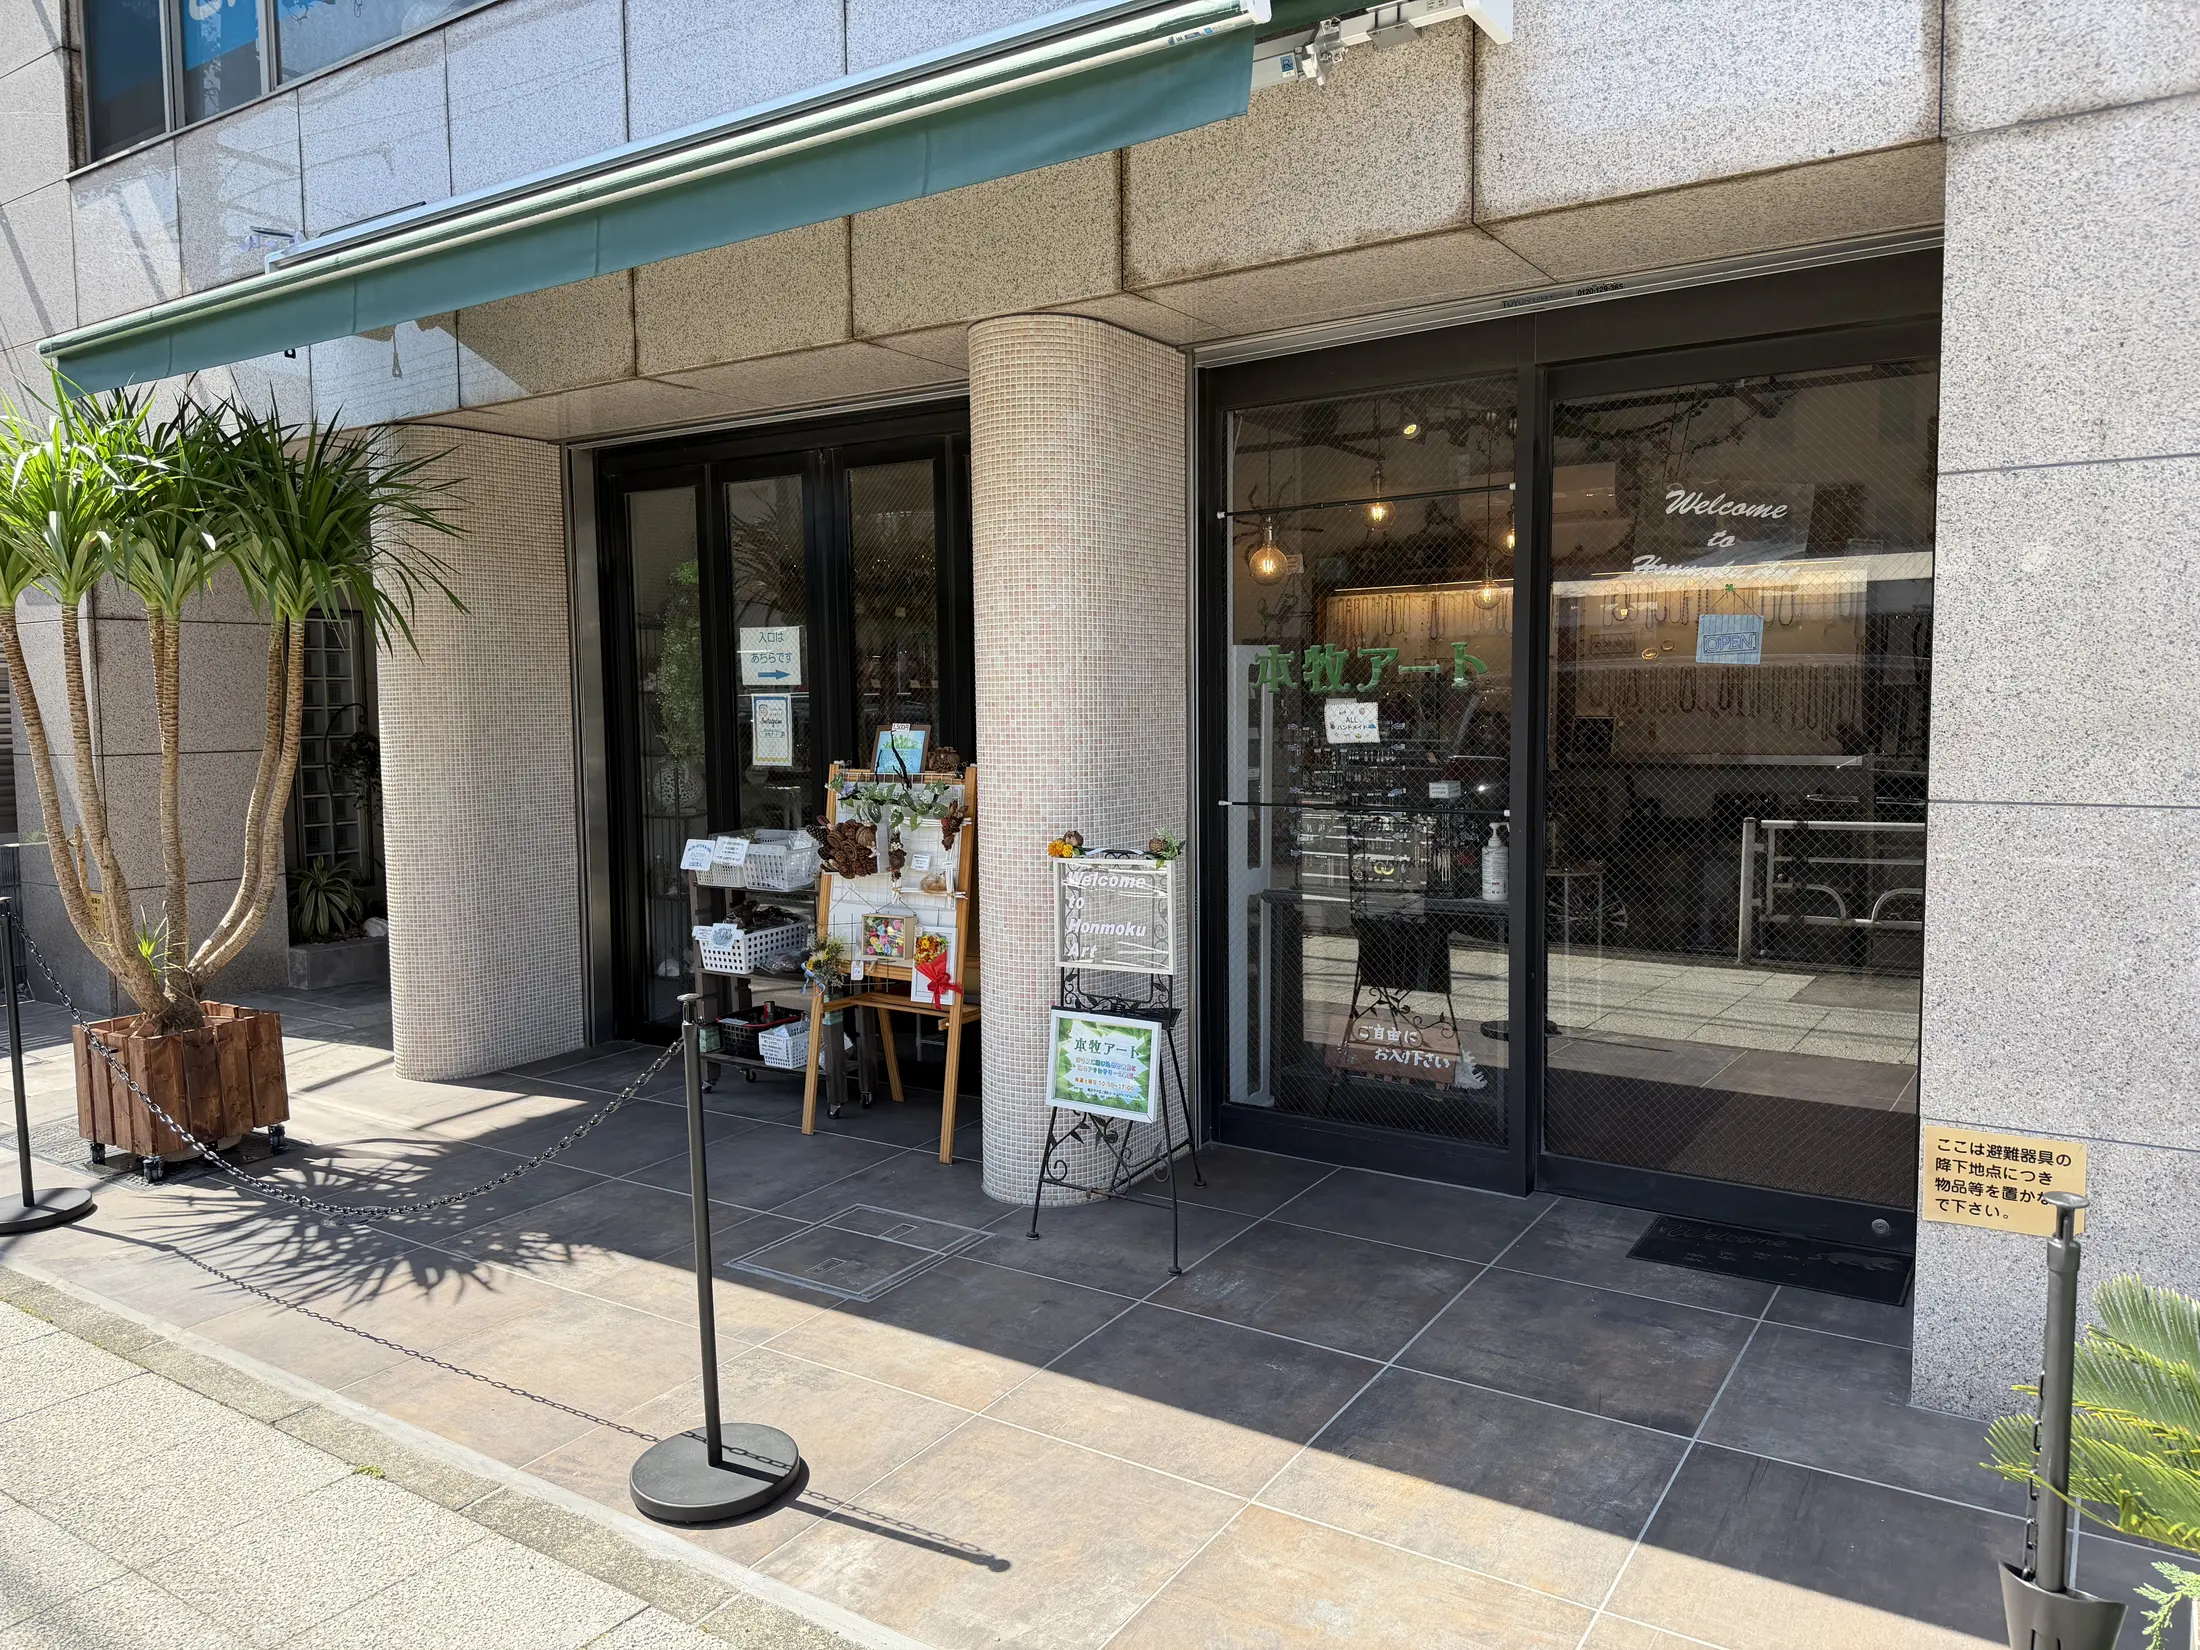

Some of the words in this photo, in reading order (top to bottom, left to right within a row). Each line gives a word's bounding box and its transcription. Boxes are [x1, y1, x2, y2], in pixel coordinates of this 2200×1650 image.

[1665, 489, 1789, 519] Welcome
[1707, 529, 1736, 548] to
[758, 631, 784, 643] 入口は
[1705, 633, 1754, 652] OPEN
[750, 652, 792, 664] あちらです
[1251, 642, 1488, 693] 本牧アート
[1067, 871, 1146, 888] Welcome
[1068, 894, 1085, 909] to
[1068, 918, 1147, 937] Honmoku
[1067, 941, 1098, 958] Art
[1359, 1024, 1417, 1043] ご自由に
[1074, 1038, 1140, 1059] 本牧アート
[1937, 1138, 2072, 1168] ここは避難器具の
[1935, 1157, 2054, 1186] 降下地点につき
[1934, 1177, 2052, 1206] 物品等を置かな
[1934, 1198, 2010, 1220] で下さい。
[1659, 1221, 1791, 1248] Welcome
